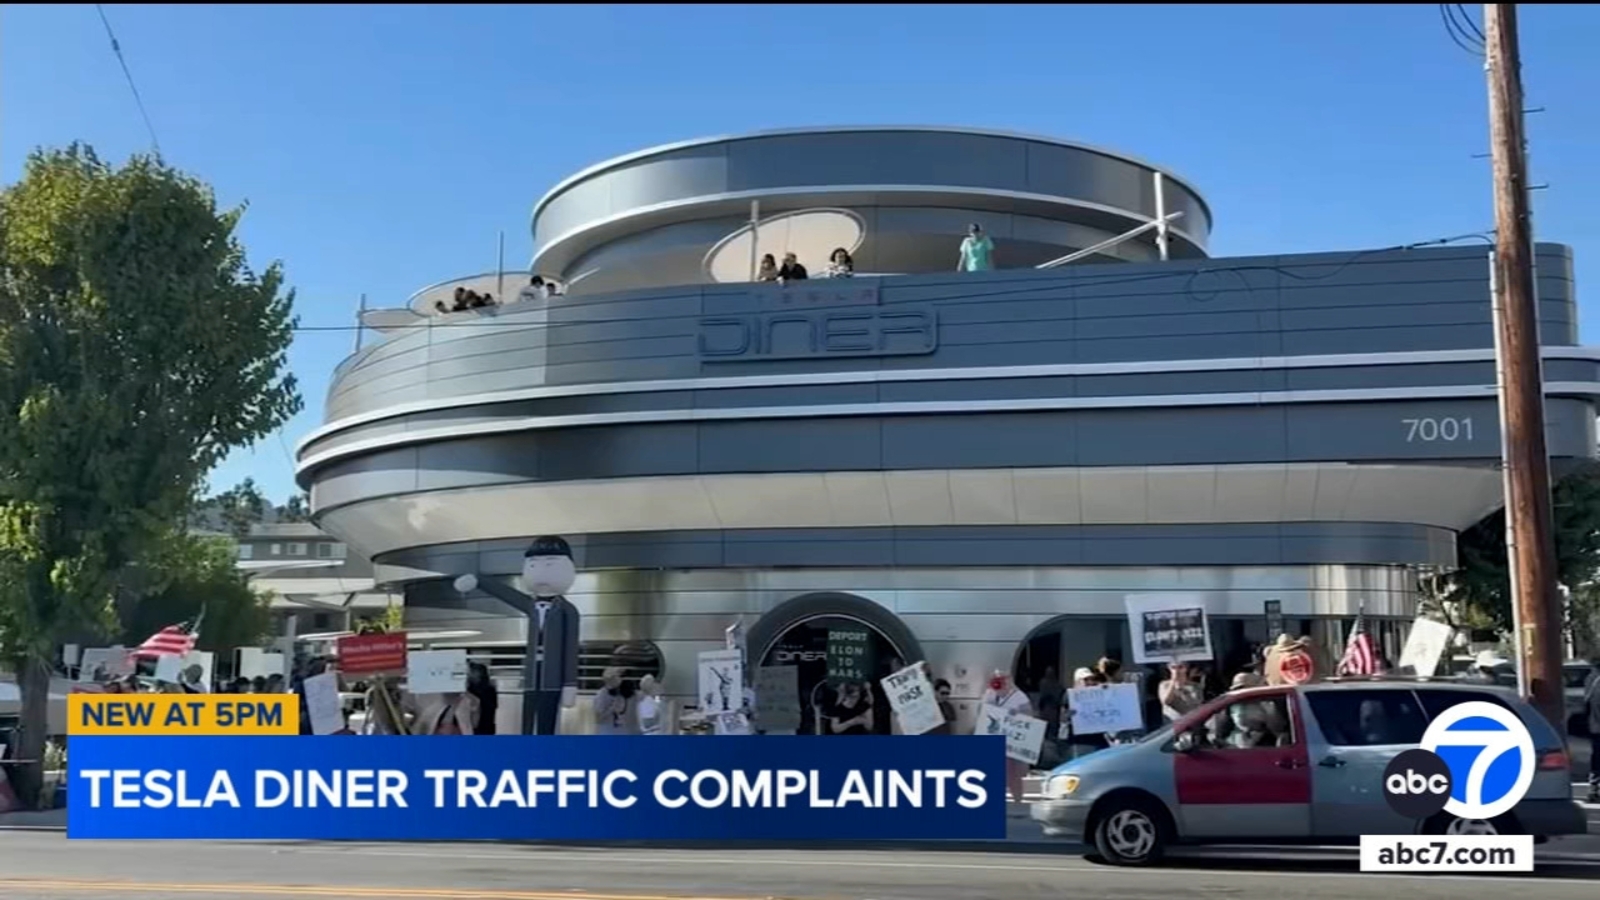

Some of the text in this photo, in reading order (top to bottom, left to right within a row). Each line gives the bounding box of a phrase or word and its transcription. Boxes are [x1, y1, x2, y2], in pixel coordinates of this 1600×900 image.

[697, 312, 934, 357] DINER
[1401, 417, 1473, 442] 7001
[828, 630, 867, 641] DEPORT
[830, 644, 864, 655] ELON
[838, 657, 854, 667] TO
[828, 668, 863, 679] MARS
